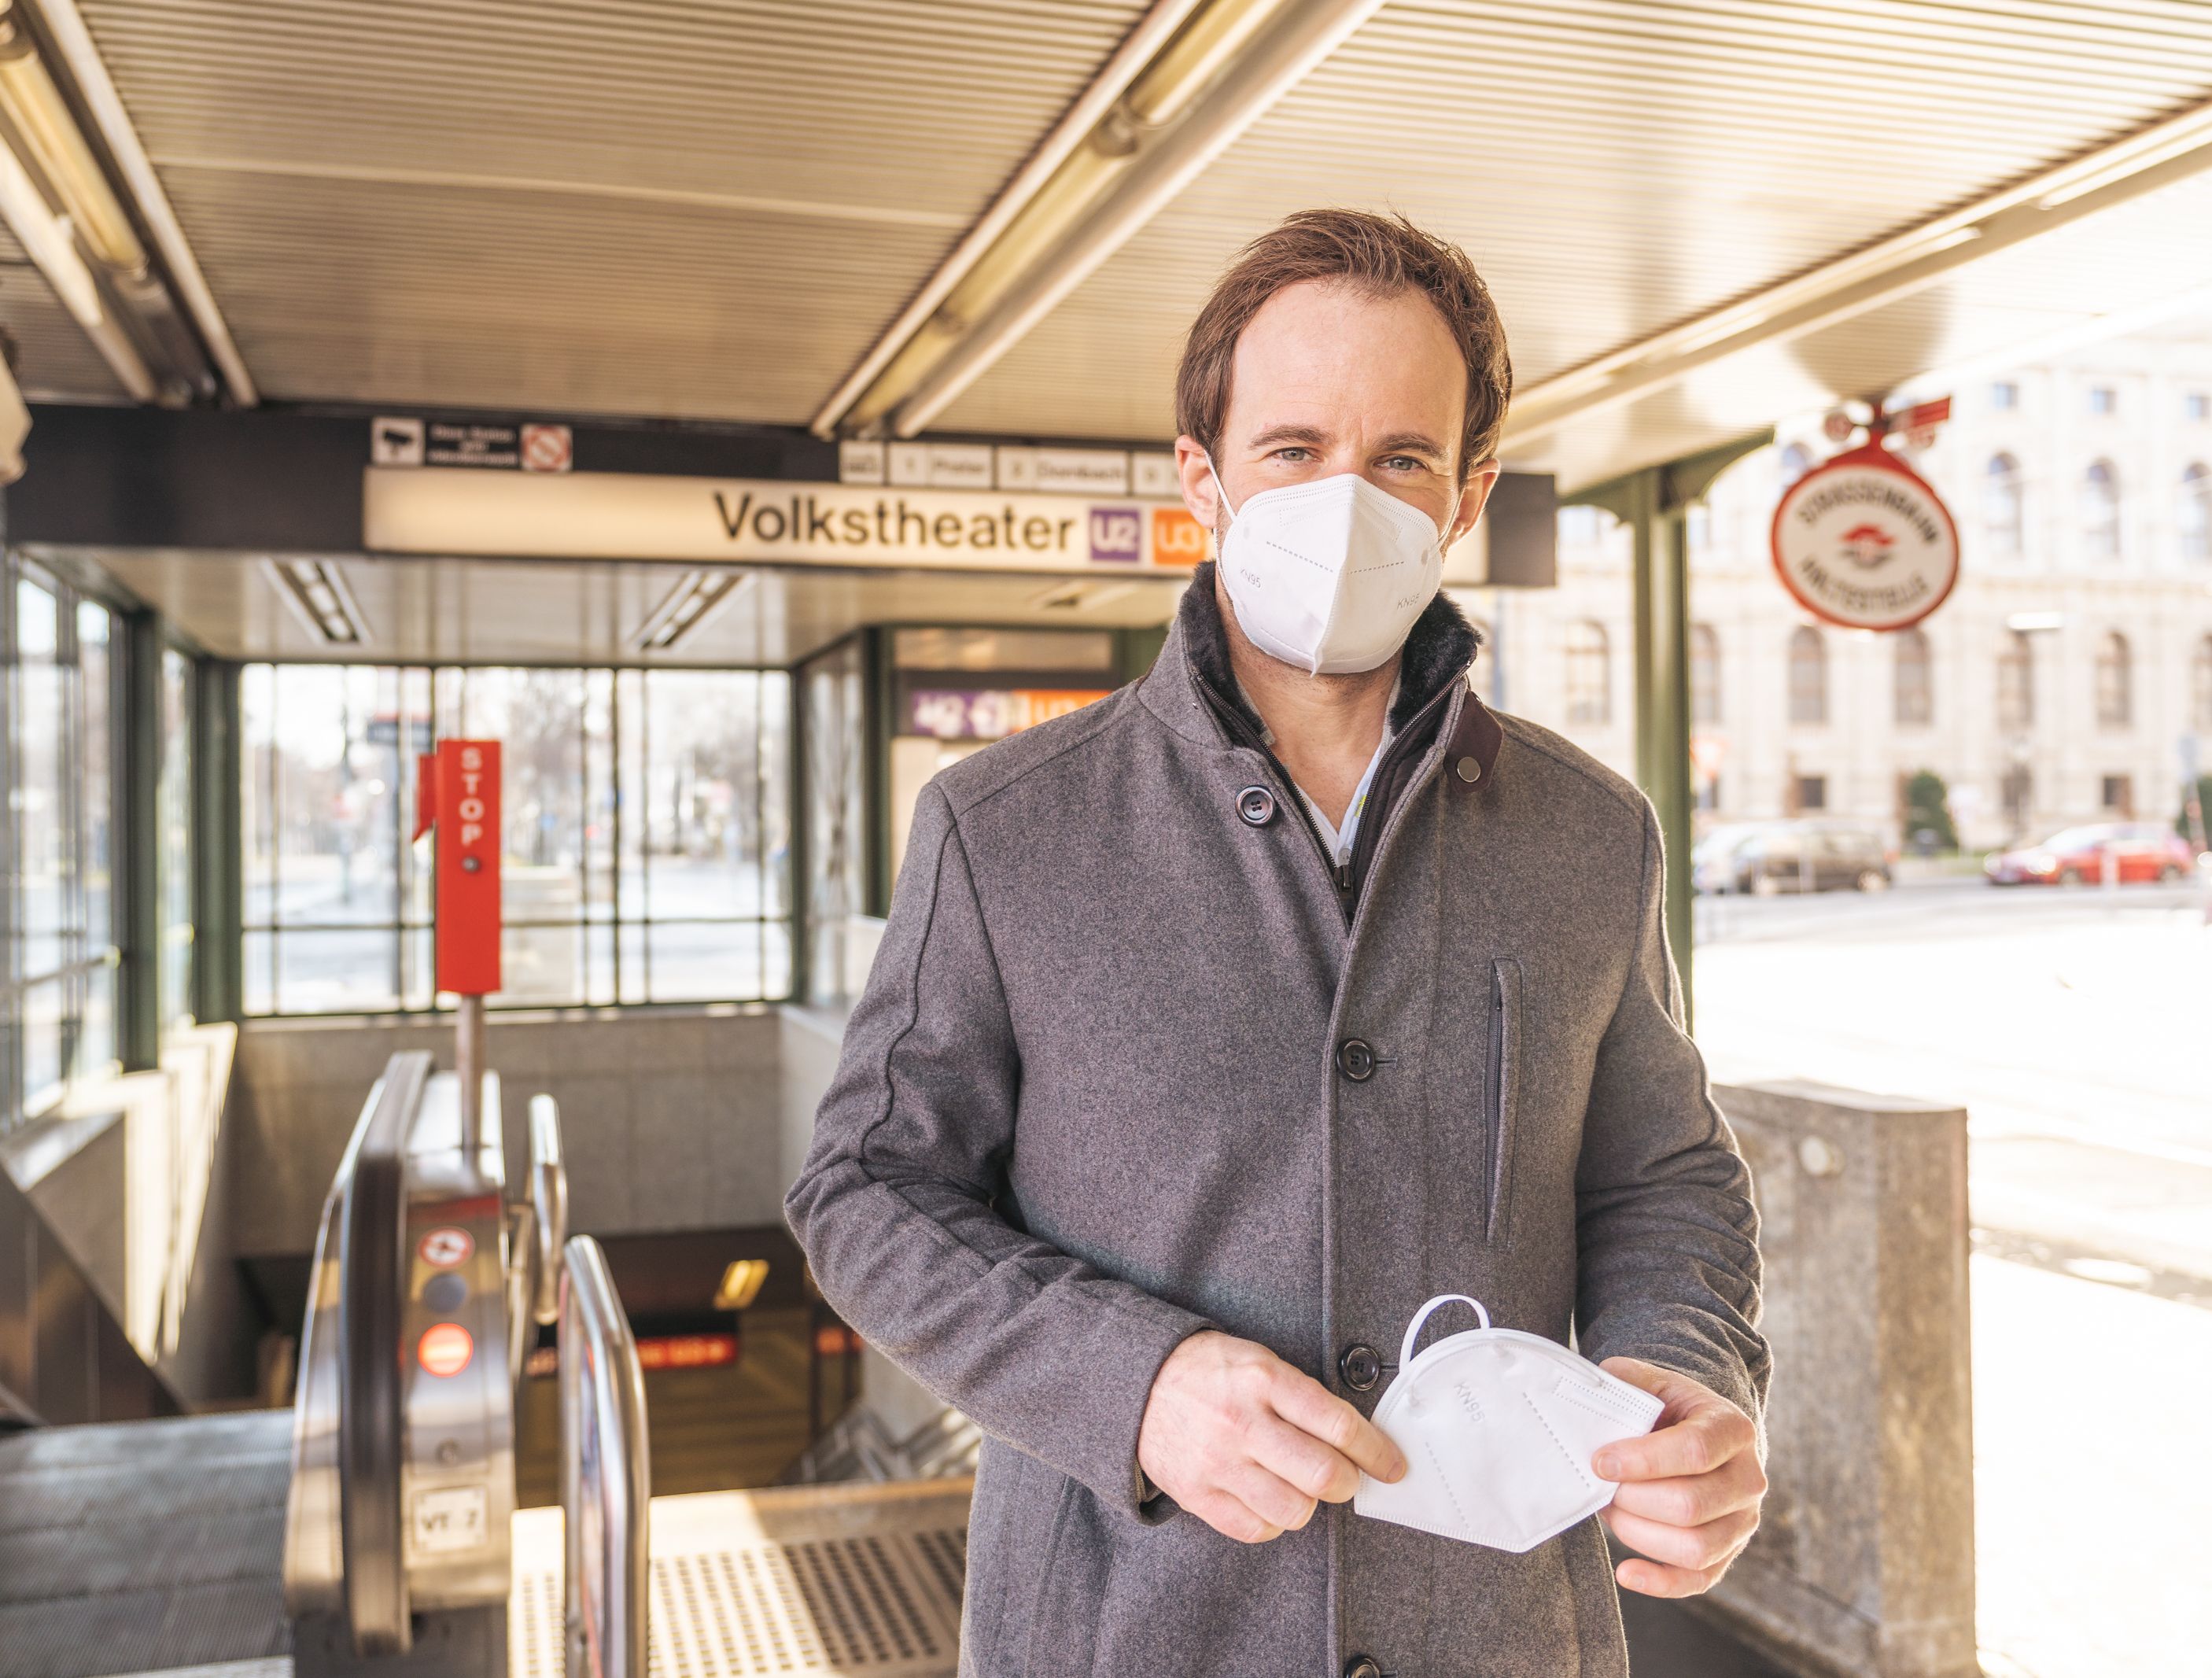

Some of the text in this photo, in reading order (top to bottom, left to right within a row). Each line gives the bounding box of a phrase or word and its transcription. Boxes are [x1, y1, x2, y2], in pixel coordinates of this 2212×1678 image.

[713, 490, 1076, 551] Volkstheater
[1092, 514, 1139, 553] U2
[459, 747, 485, 847] STOP
[1453, 1381, 1486, 1422] KN95
